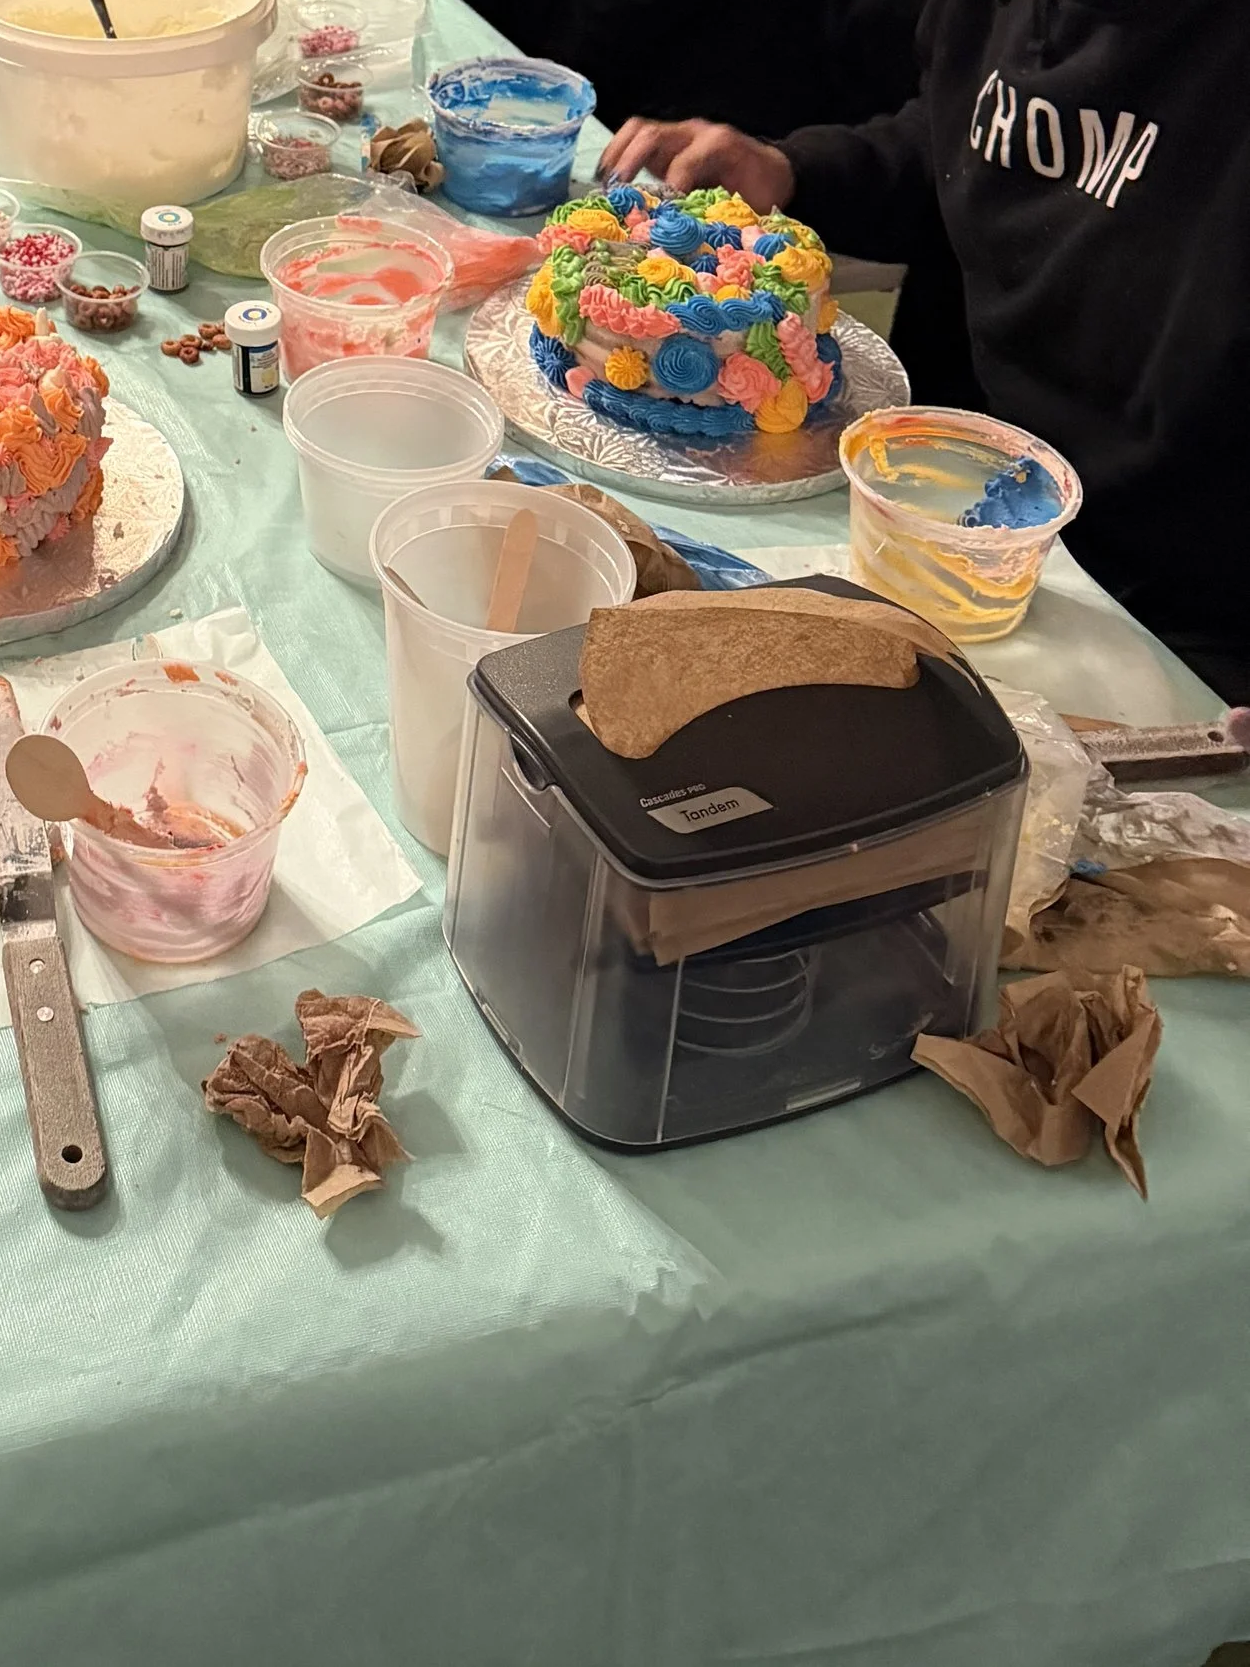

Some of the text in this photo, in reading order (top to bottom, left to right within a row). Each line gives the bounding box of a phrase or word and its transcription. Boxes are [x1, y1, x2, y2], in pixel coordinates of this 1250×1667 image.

[970, 69, 1159, 209] CHOMP
[639, 789, 687, 808] Cascades
[679, 799, 740, 823] Tandem
